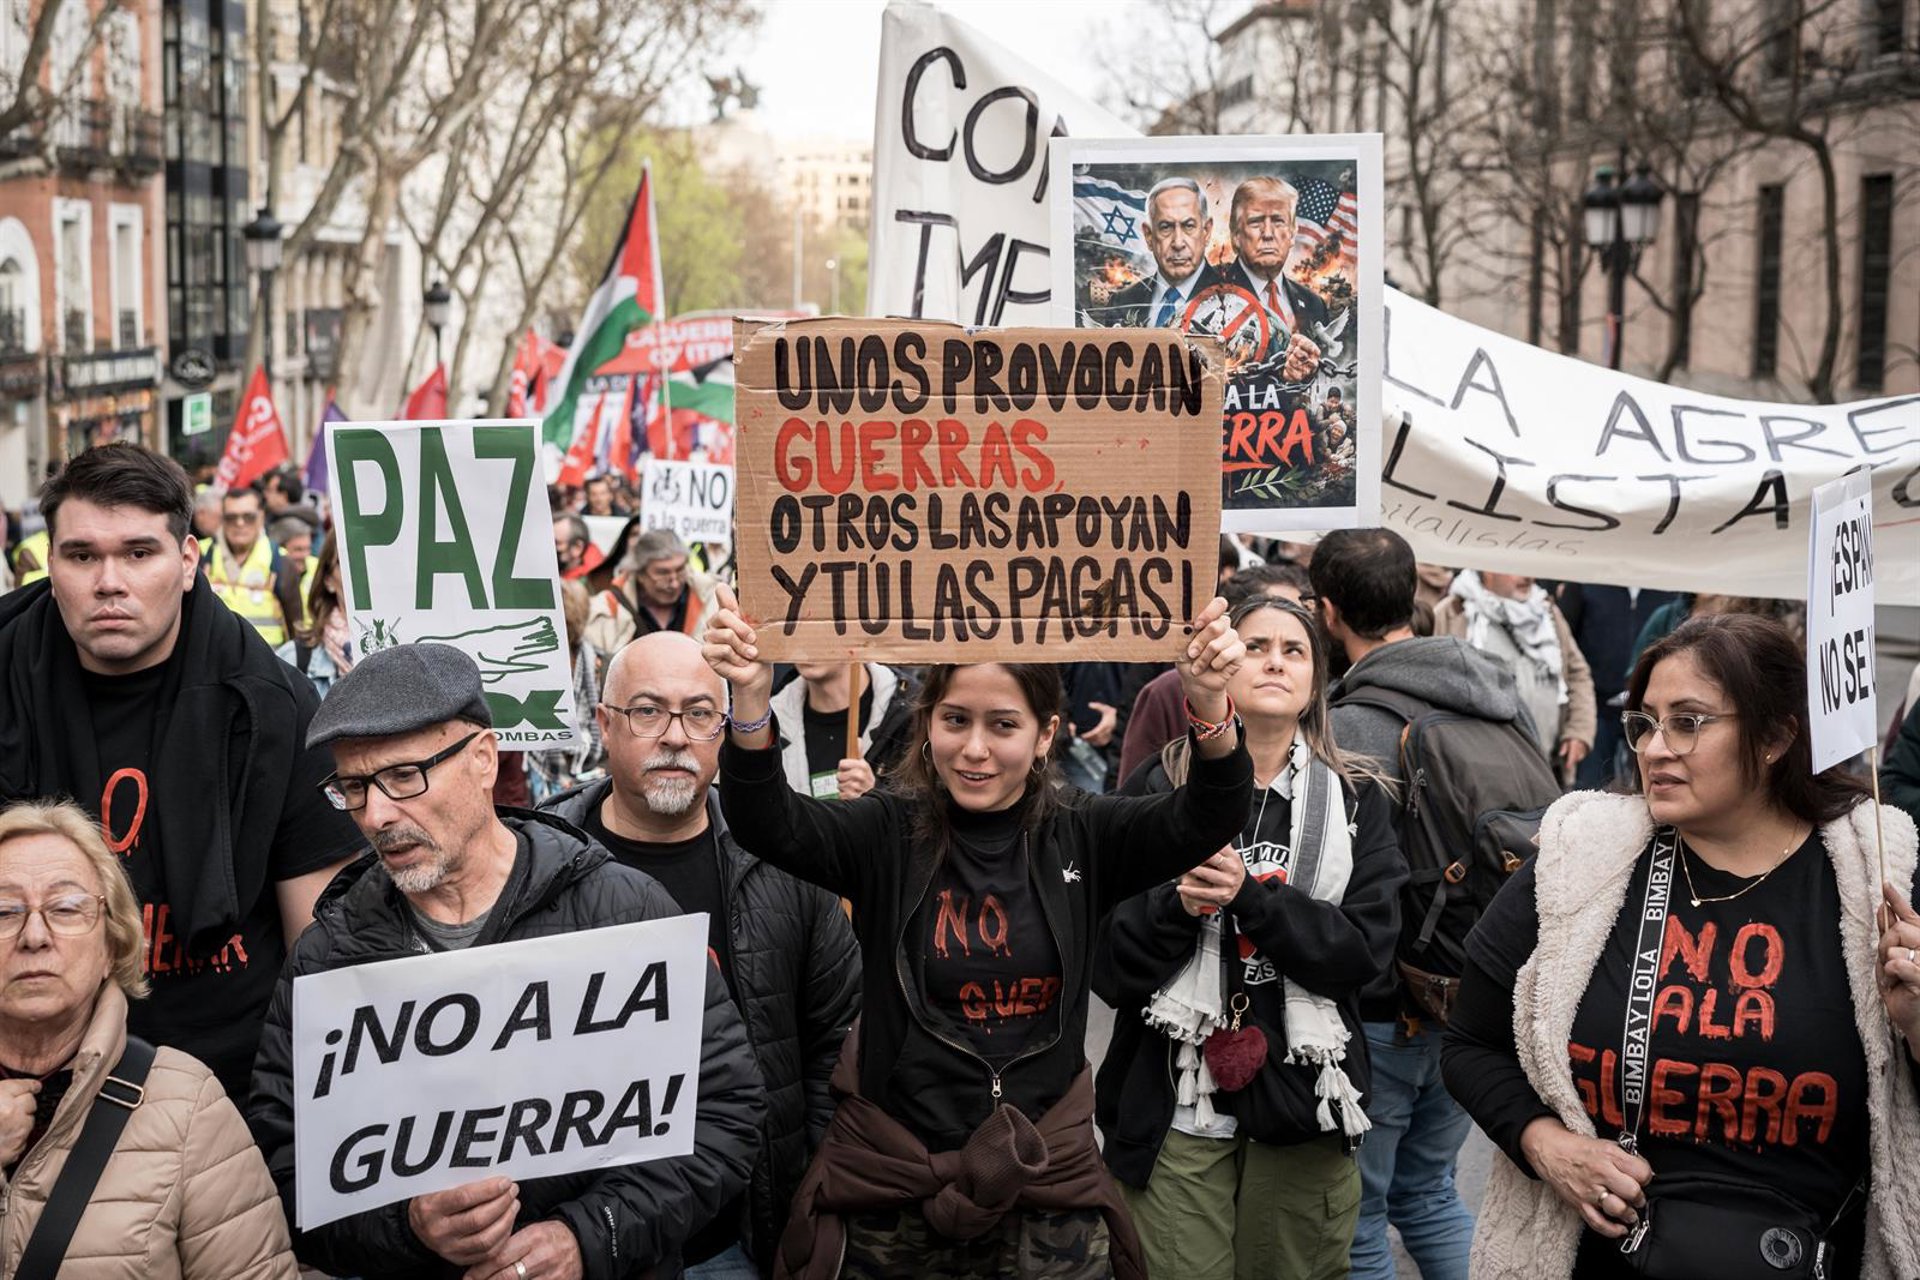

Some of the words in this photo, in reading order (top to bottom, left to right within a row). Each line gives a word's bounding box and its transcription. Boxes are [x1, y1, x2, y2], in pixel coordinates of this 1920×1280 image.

[774, 331, 931, 415] UNOS
[942, 339, 1202, 417] PROVOCAN
[1223, 384, 1242, 409] A
[1249, 384, 1281, 409] LA
[1382, 305, 1520, 437] LA
[774, 416, 1065, 494] GUERRAS,
[1596, 389, 1920, 463] AGRE
[689, 469, 727, 509] NO
[1382, 411, 1789, 535] LISTA
[333, 426, 556, 610] PAZ
[682, 517, 726, 537] guerra
[769, 493, 919, 553] OTROS
[927, 491, 1012, 550] LAS
[1015, 490, 1191, 552] APOYAN
[770, 561, 818, 636] Y
[820, 554, 890, 636] TÚ
[900, 558, 1000, 642] LAS
[1008, 555, 1194, 645] PAGAS!
[1820, 637, 1841, 715] NO
[1844, 629, 1869, 705] SE
[1259, 846, 1290, 869] MU
[934, 889, 1011, 959] NO
[1659, 914, 1785, 992] NO
[1638, 948, 1658, 1002] LOLA
[312, 992, 481, 1099] ¡NO
[491, 980, 552, 1051] A
[573, 960, 669, 1036] LA
[328, 1073, 686, 1195] GUERRA!
